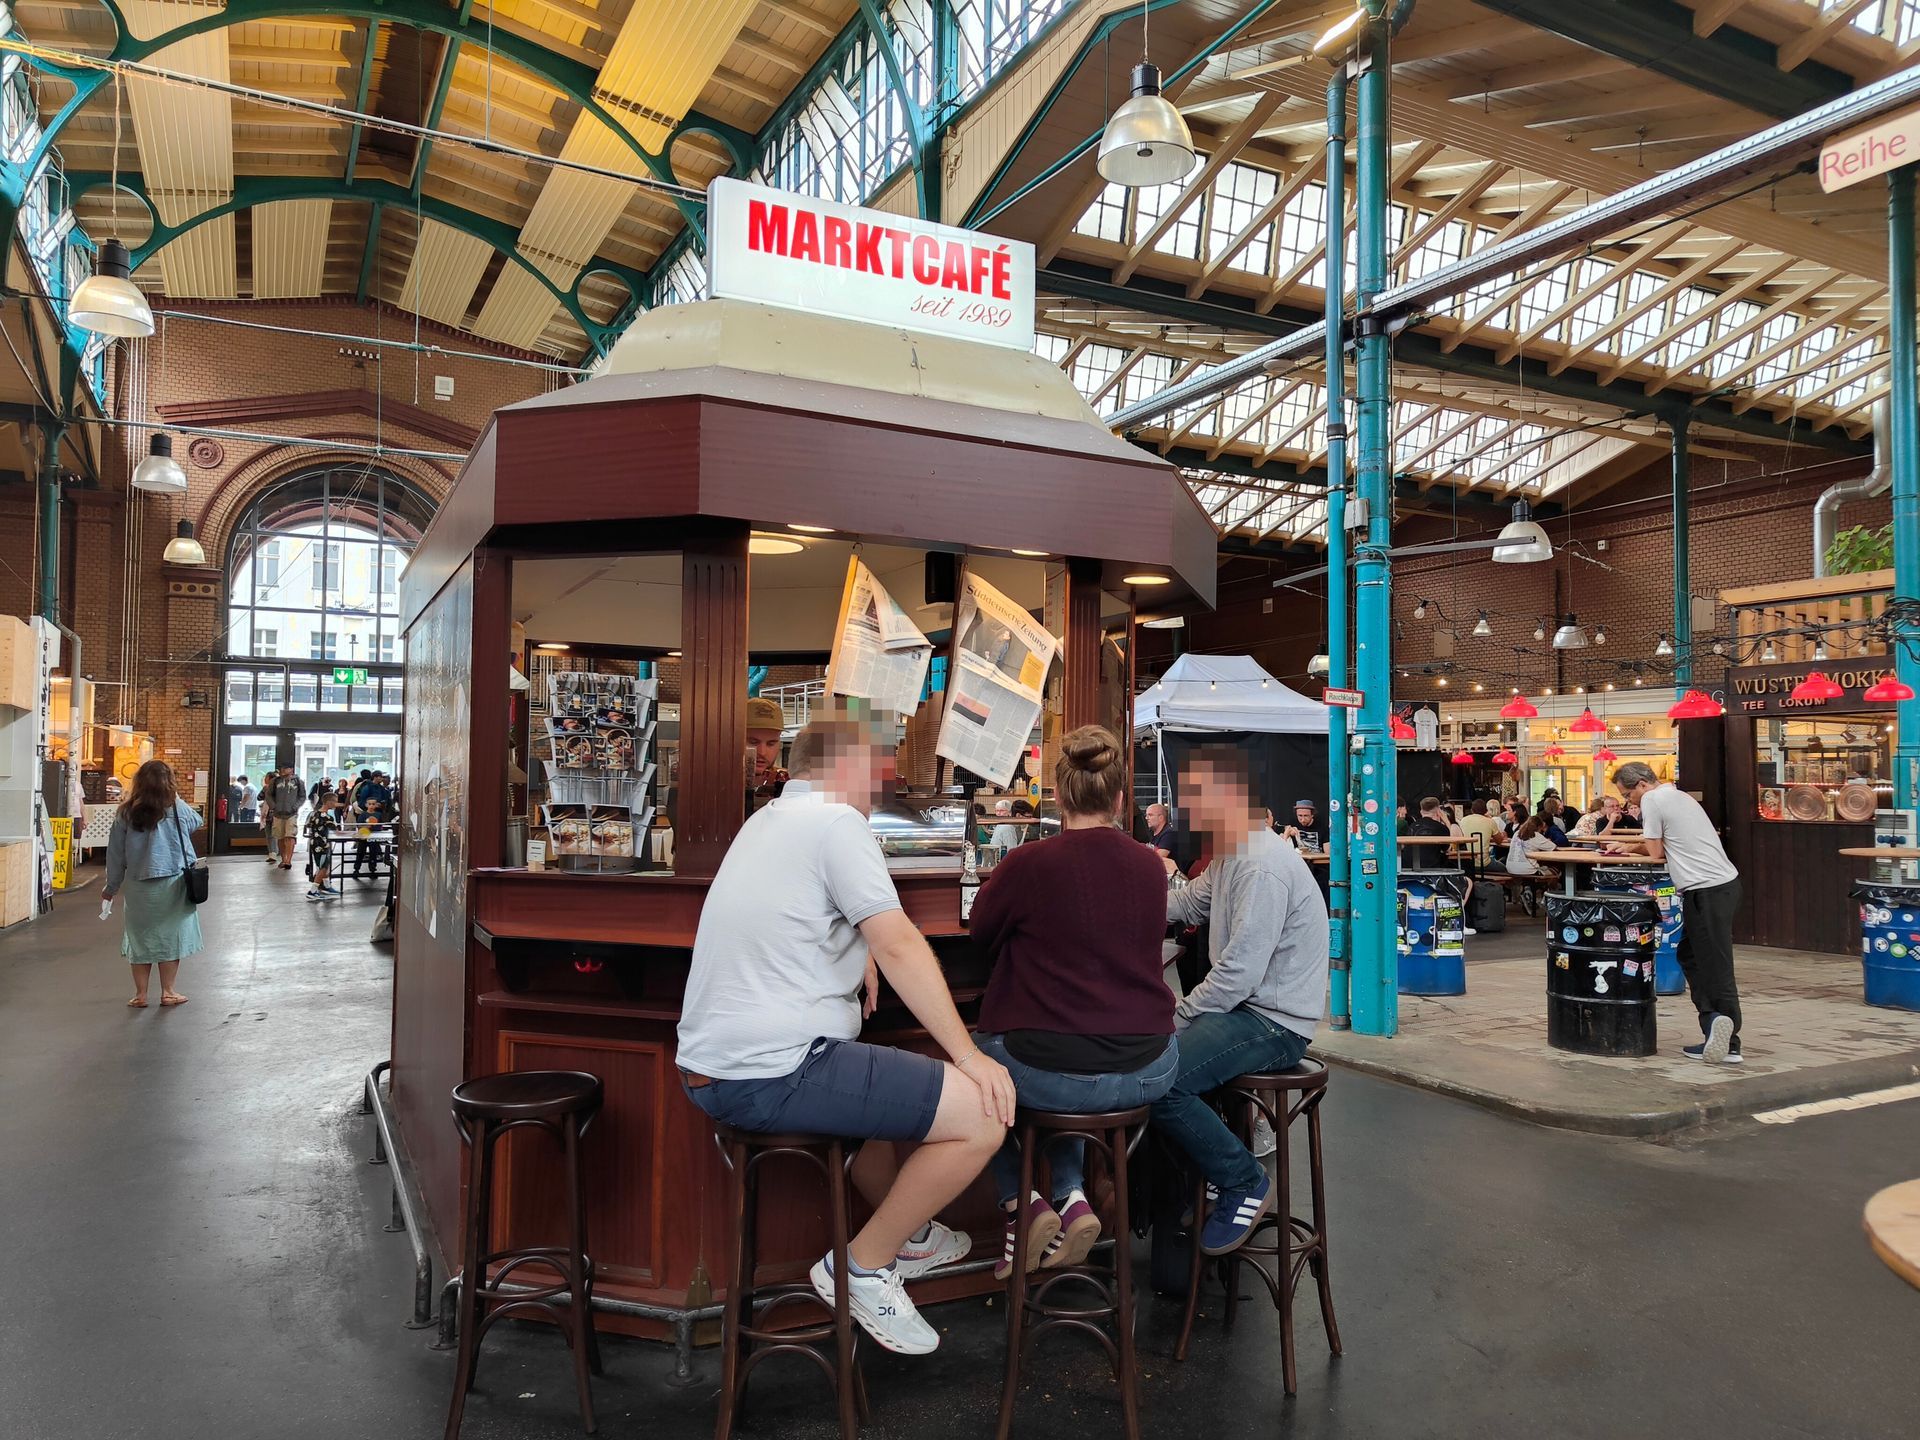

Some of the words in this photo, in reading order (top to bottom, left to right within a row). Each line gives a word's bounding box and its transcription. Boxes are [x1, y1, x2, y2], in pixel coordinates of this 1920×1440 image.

[1822, 134, 1907, 185] Reihe
[748, 199, 1011, 300] MARKTCAFÉ
[910, 294, 955, 318] seit
[958, 304, 1012, 328] 1989
[1020, 622, 1048, 651] Zeitung
[1741, 700, 1765, 711] TEE
[1778, 697, 1826, 708] LOKUM
